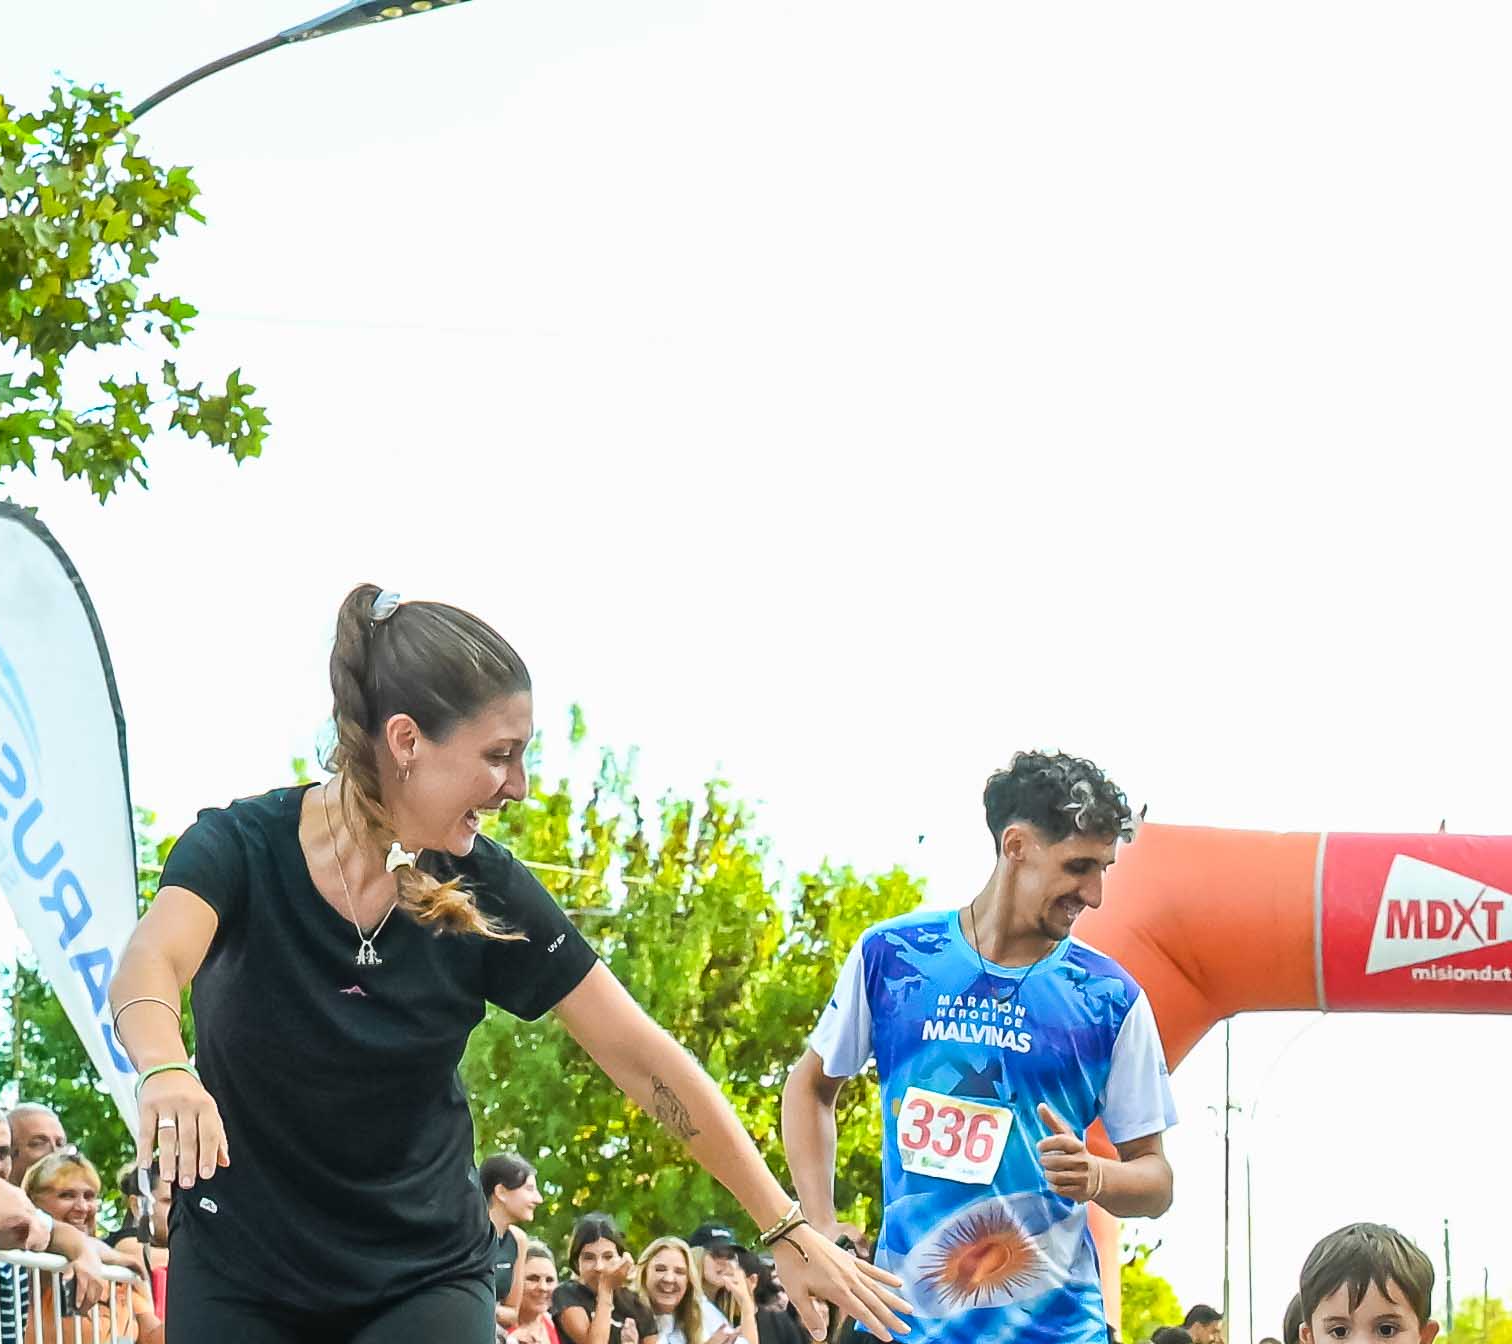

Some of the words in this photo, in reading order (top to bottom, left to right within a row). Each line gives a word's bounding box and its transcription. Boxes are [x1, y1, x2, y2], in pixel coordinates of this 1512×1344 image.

[1385, 888, 1504, 945] MDXT
[922, 1019, 1033, 1054] MALVINAS
[902, 1098, 999, 1164] 336
